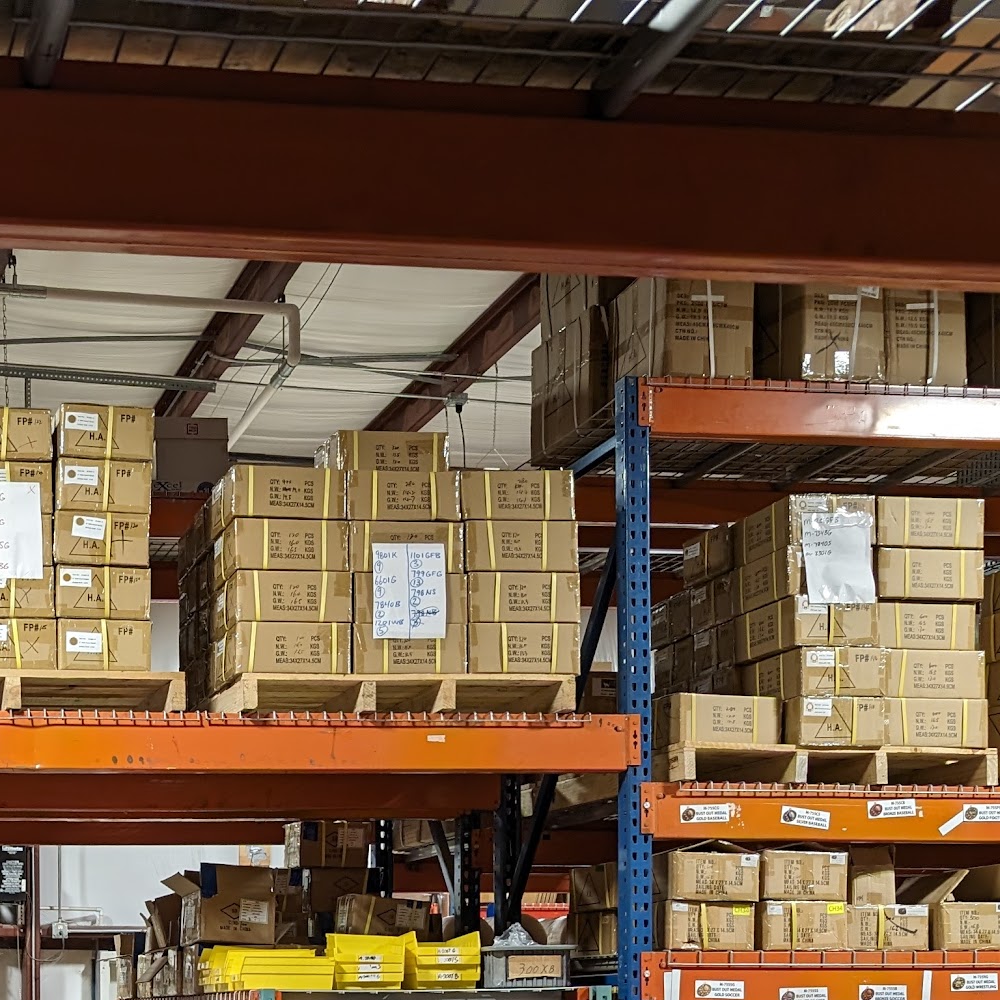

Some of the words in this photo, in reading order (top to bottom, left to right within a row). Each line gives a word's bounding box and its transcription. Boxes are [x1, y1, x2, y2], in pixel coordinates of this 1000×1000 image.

[17, 417, 33, 426] FP#
[121, 414, 136, 423] FP#
[19, 468, 35, 477] FP#
[116, 469, 131, 478] FP#
[84, 488, 102, 496] H.A.
[113, 521, 131, 530] FP#
[82, 540, 100, 550] H.A.
[118, 575, 134, 584] FP#
[87, 593, 104, 602] H.A.
[23, 623, 40, 632] FP#
[855, 654, 870, 663] FP#
[827, 723, 843, 732] H.A.
